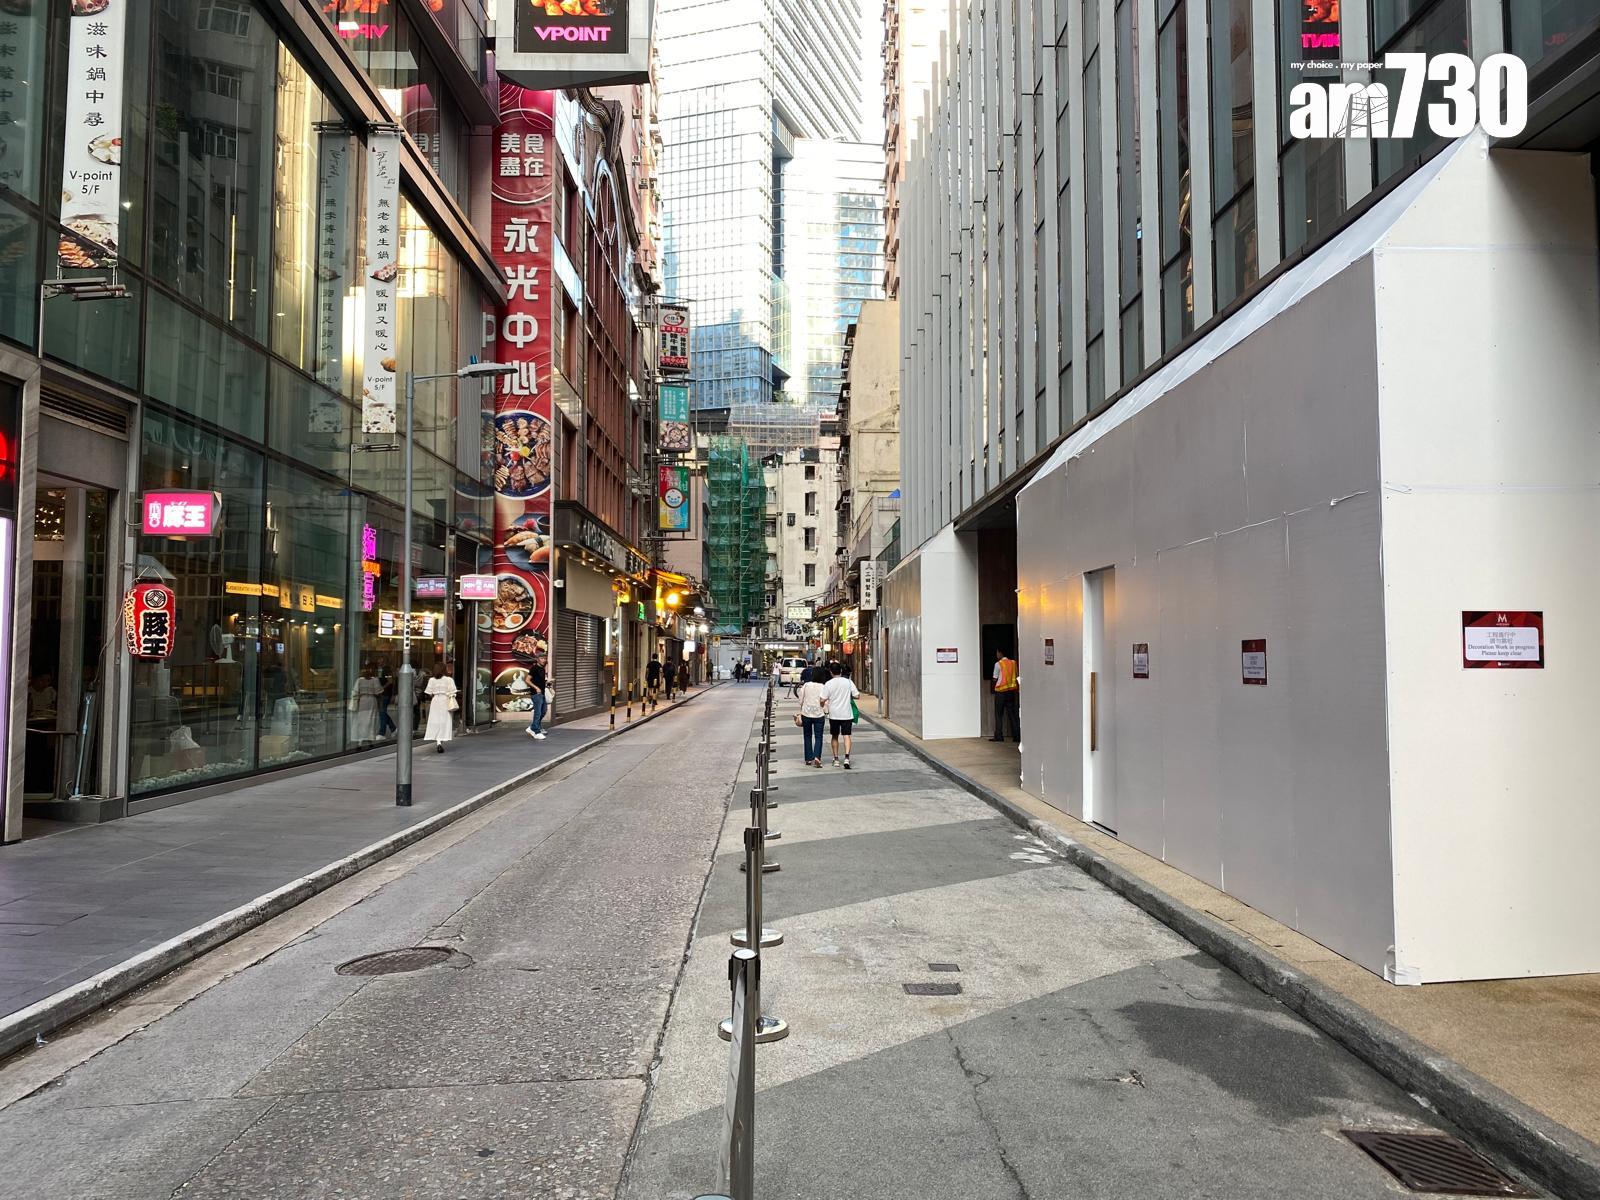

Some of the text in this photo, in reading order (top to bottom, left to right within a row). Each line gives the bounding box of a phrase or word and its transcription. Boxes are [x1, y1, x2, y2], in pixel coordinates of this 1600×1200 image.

[533, 26, 611, 42] VPOINT
[83, 22, 109, 127] 滋味鍋中尋
[500, 132, 545, 154] 美食
[69, 170, 113, 182] V-point
[500, 156, 545, 177] 盡在
[81, 184, 100, 195] 5/F
[376, 198, 390, 260] 無老養生鍋
[502, 216, 539, 397] 永光中心
[374, 288, 389, 352] 暖胃又暖心
[367, 376, 393, 384] V-point
[141, 611, 169, 656] 豚王
